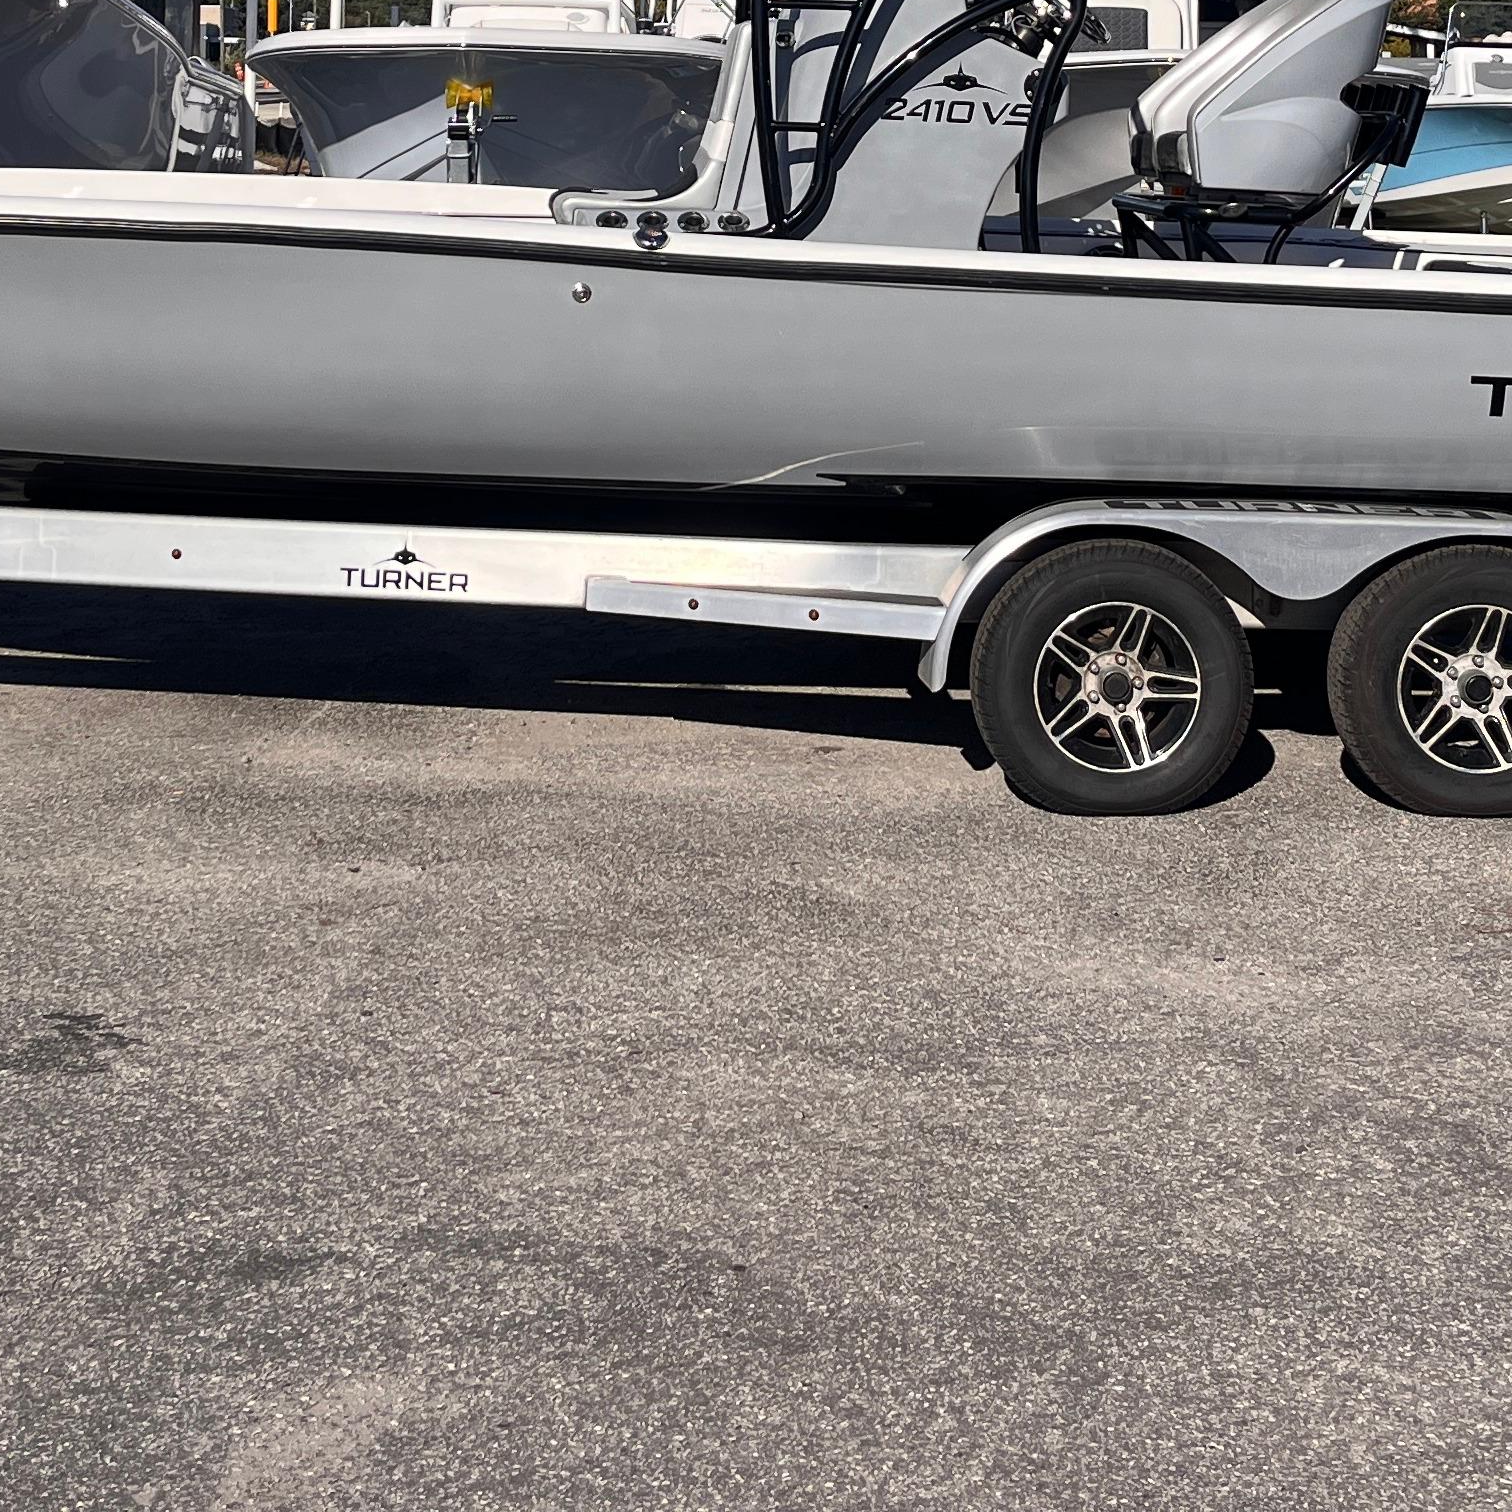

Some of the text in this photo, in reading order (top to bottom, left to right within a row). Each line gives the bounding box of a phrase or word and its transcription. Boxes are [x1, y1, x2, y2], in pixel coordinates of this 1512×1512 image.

[880, 97, 1032, 127] 2410 VS
[340, 567, 469, 593] TURNER
